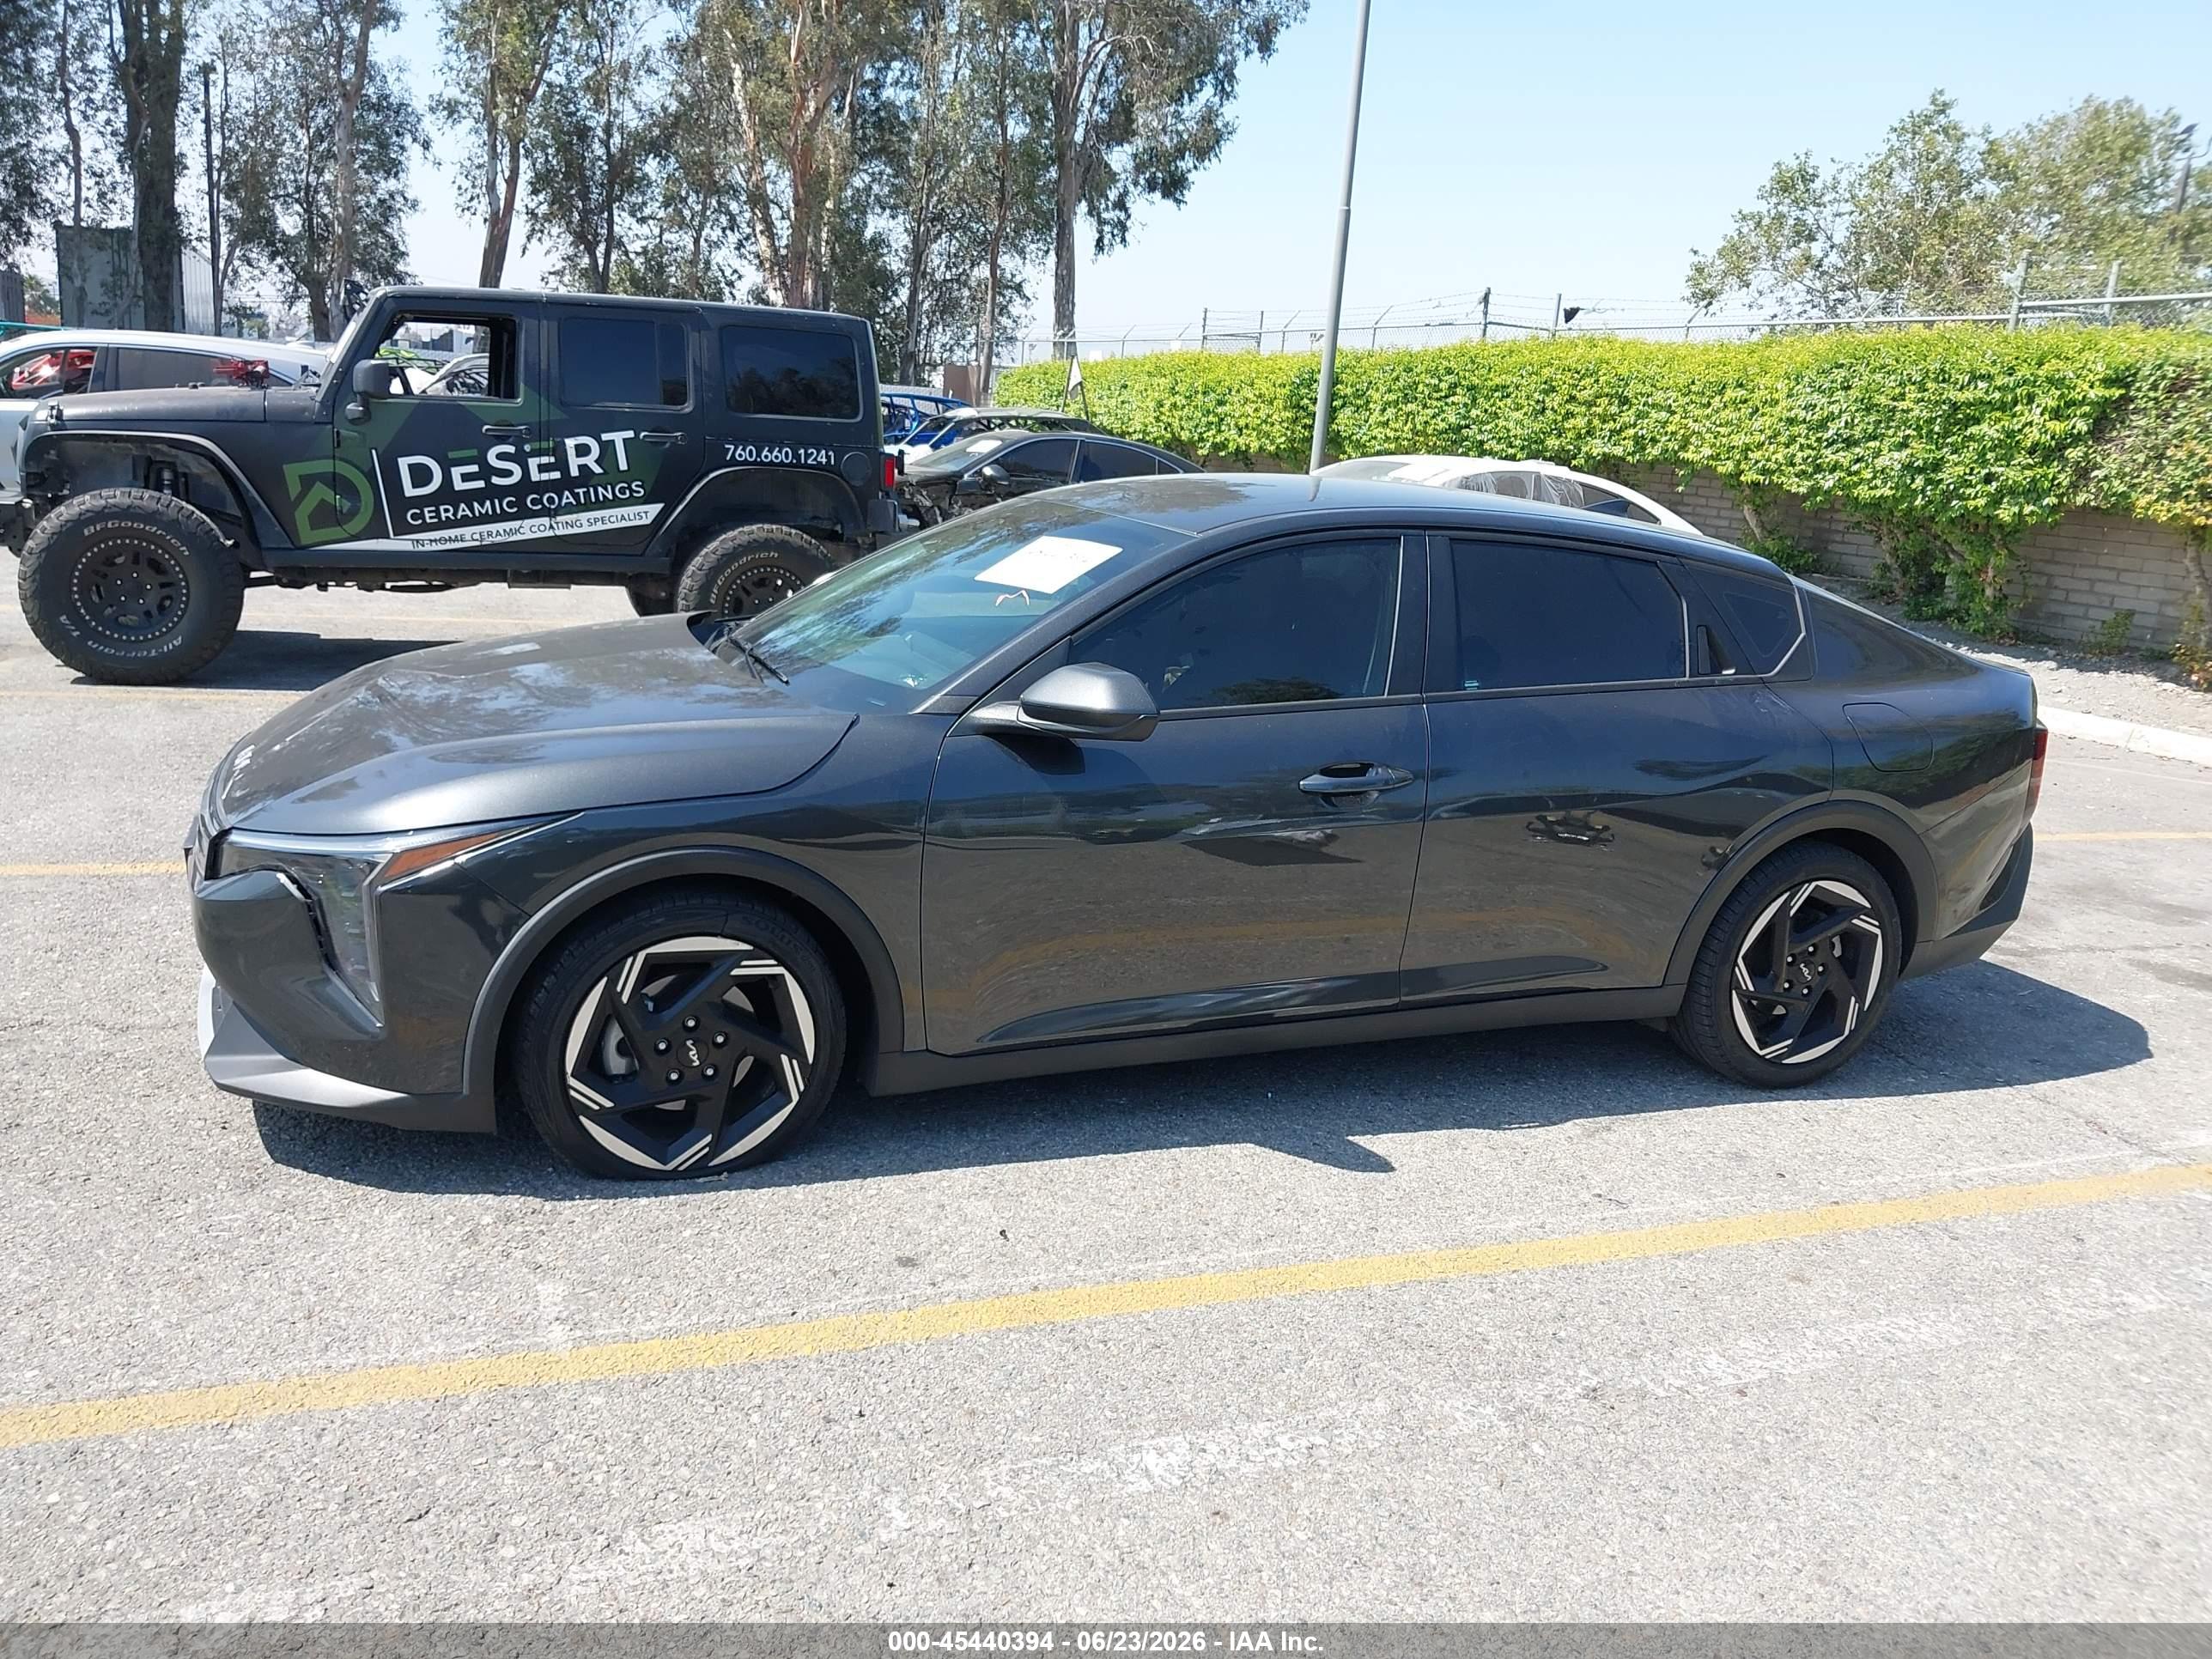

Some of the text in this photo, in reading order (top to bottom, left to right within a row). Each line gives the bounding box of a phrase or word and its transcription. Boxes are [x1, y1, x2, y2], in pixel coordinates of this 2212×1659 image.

[397, 429, 635, 498] DESERT
[724, 444, 835, 465] 760.660.1241
[406, 481, 645, 526] CERAMIC COATINGS
[83, 520, 189, 556] BFGoodrich
[411, 511, 650, 550] IN-HOME CERAMIC COATING SPECIALIST
